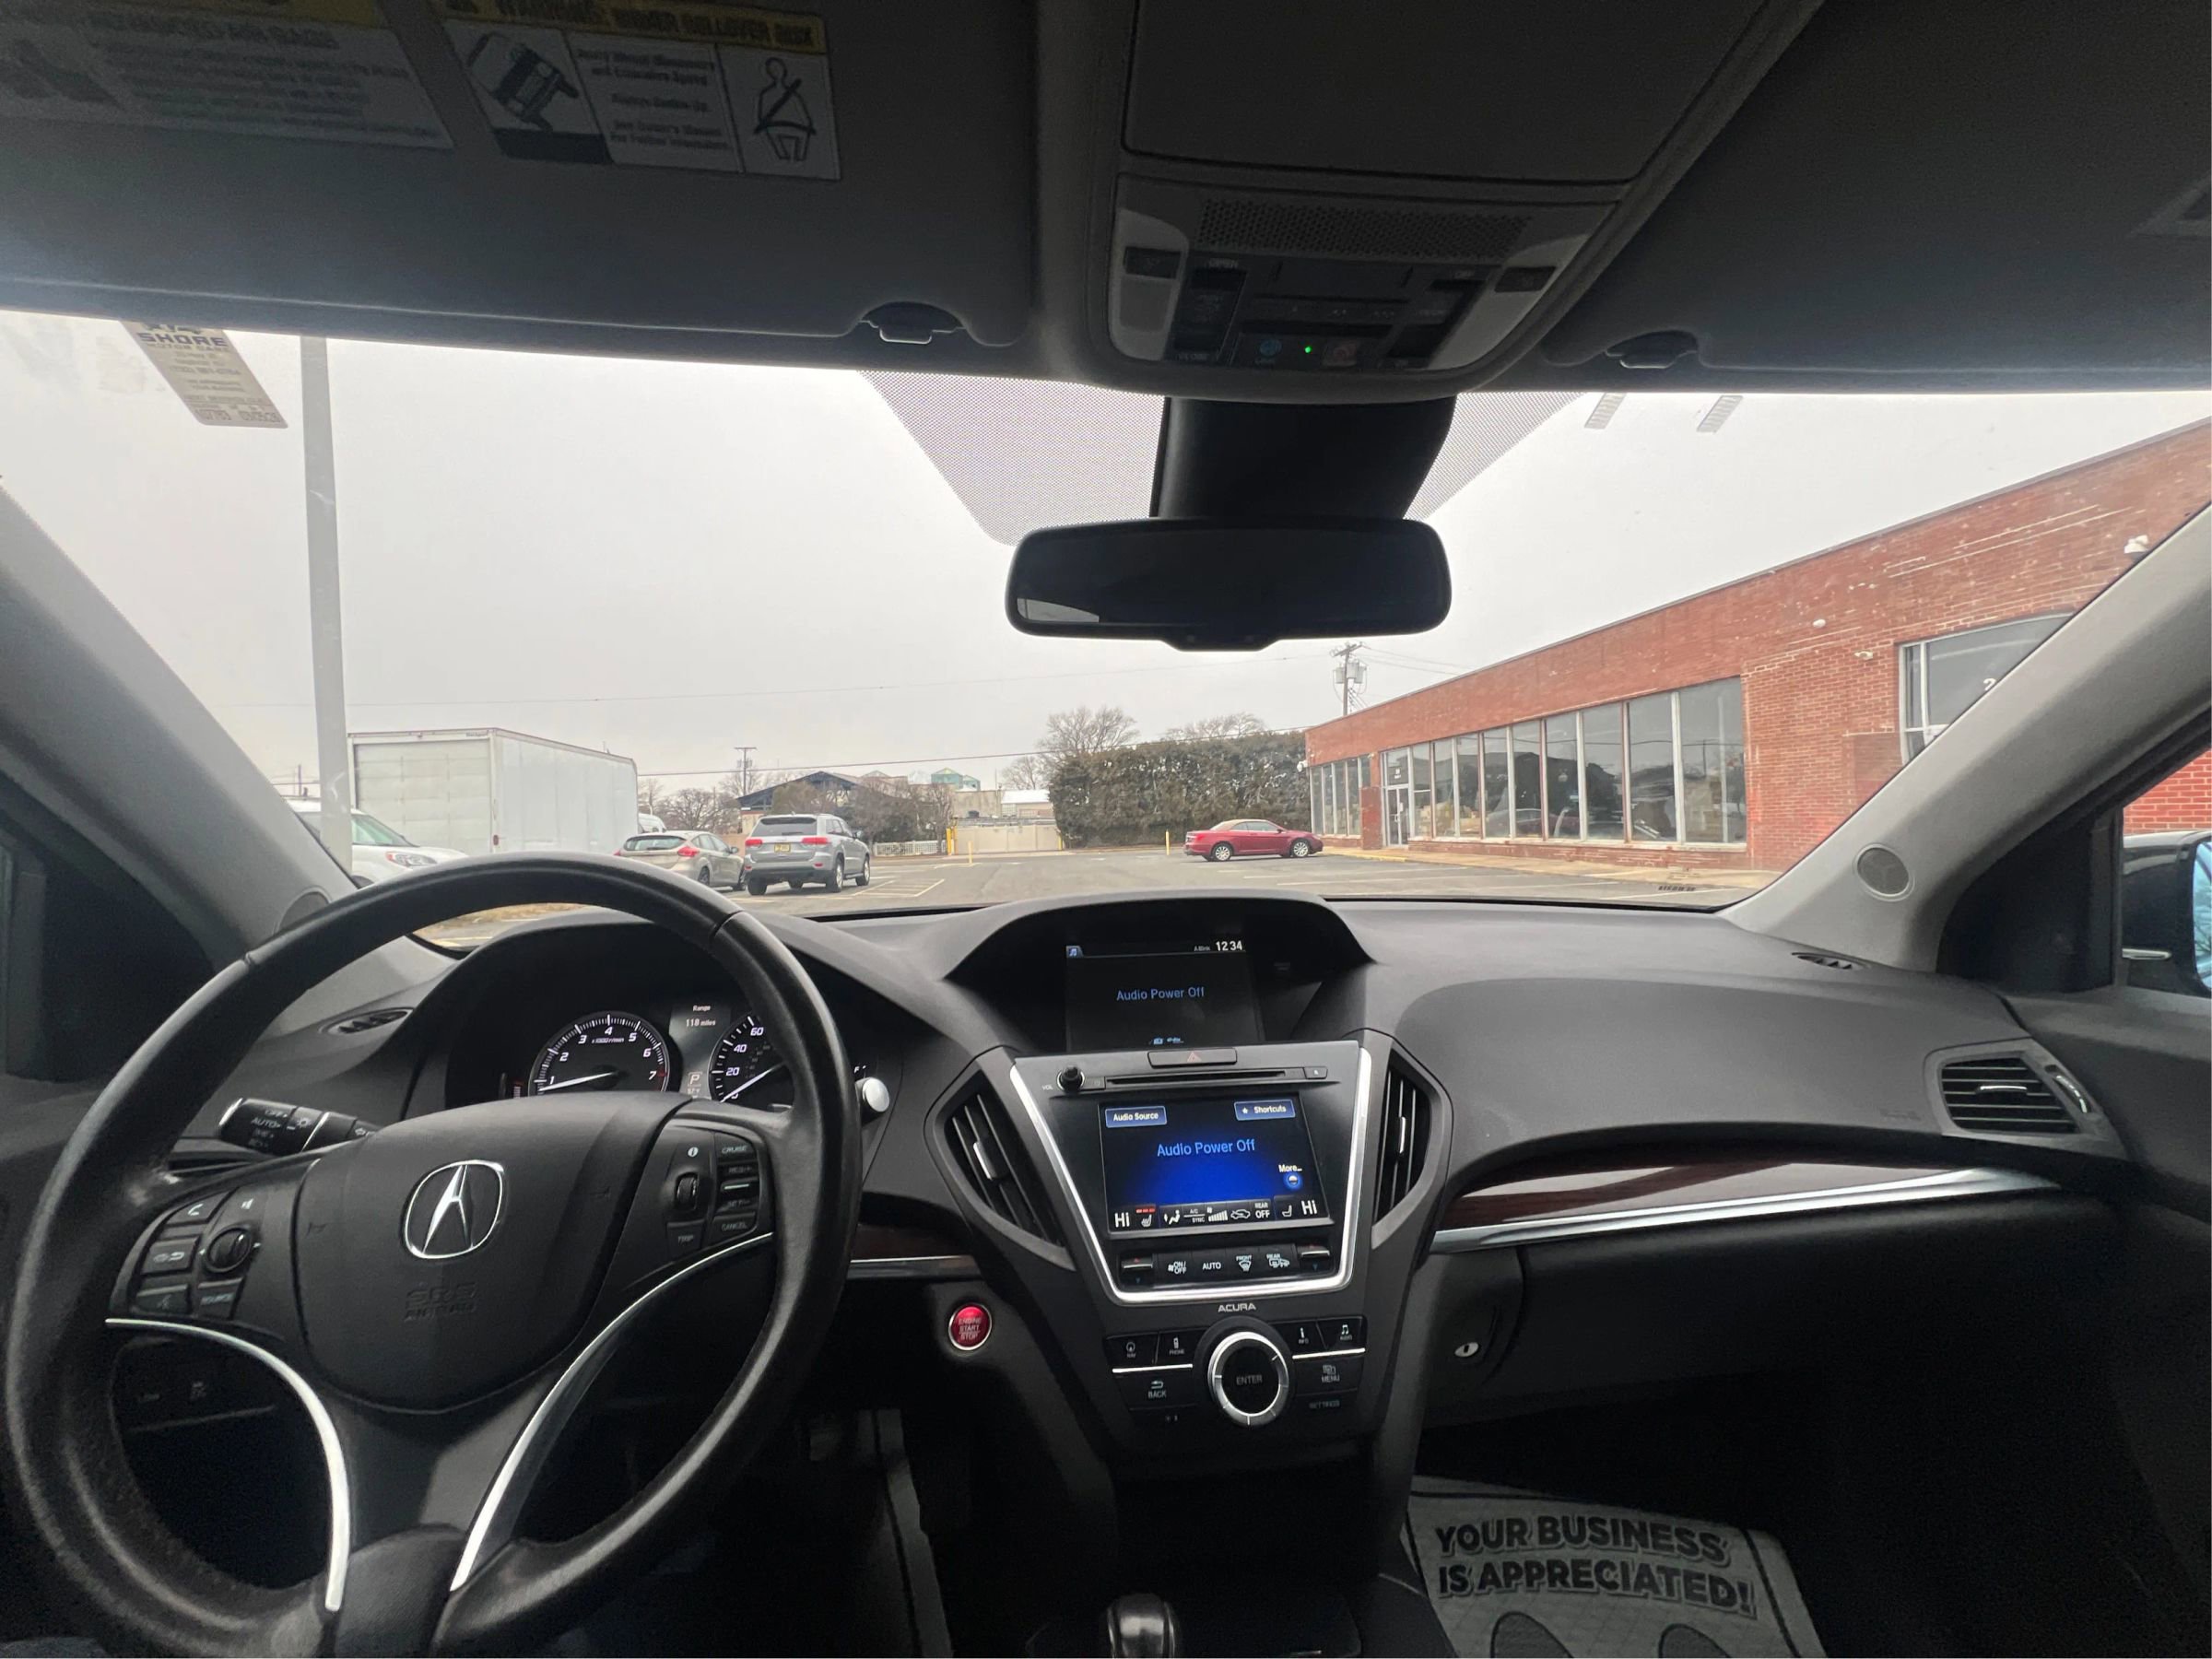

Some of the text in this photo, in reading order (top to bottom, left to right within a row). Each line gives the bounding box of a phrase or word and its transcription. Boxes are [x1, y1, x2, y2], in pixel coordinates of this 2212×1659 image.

[137, 333, 229, 347] SHORE
[1116, 986, 1206, 1002] Audio Power Off
[692, 1005, 712, 1013] Range
[604, 1026, 614, 1036] 4
[749, 1027, 765, 1036] 60
[578, 1034, 588, 1044] 3
[628, 1031, 638, 1042] 5
[642, 1047, 653, 1058] 6
[733, 1043, 747, 1053] 40
[559, 1052, 570, 1062] 2
[648, 1070, 657, 1080] 7
[724, 1066, 740, 1077] 20
[548, 1076, 556, 1085] 1
[689, 1073, 700, 1085] P
[1253, 1104, 1288, 1114] Shortcuts
[1112, 1111, 1159, 1122] Audio Source
[251, 1116, 277, 1129] AUTO
[1157, 1138, 1255, 1158] Audio Power Off
[1300, 1199, 1318, 1216] Hi
[1254, 1209, 1271, 1219] OFF
[1114, 1211, 1131, 1228] Hi
[1173, 1266, 1187, 1276] OFF
[1202, 1261, 1222, 1271] AUTO
[1218, 1302, 1257, 1313] ACURA
[958, 1317, 982, 1325] ENGINE
[959, 1324, 980, 1333] START
[960, 1332, 979, 1340] STOP
[1235, 1373, 1263, 1386] ENTER
[1321, 1374, 1340, 1383] MENU
[1147, 1390, 1167, 1399] BACK
[1435, 1515, 1729, 1564] YOUR BUSINESS
[1438, 1559, 1755, 1615] IS APPRECIATED!
